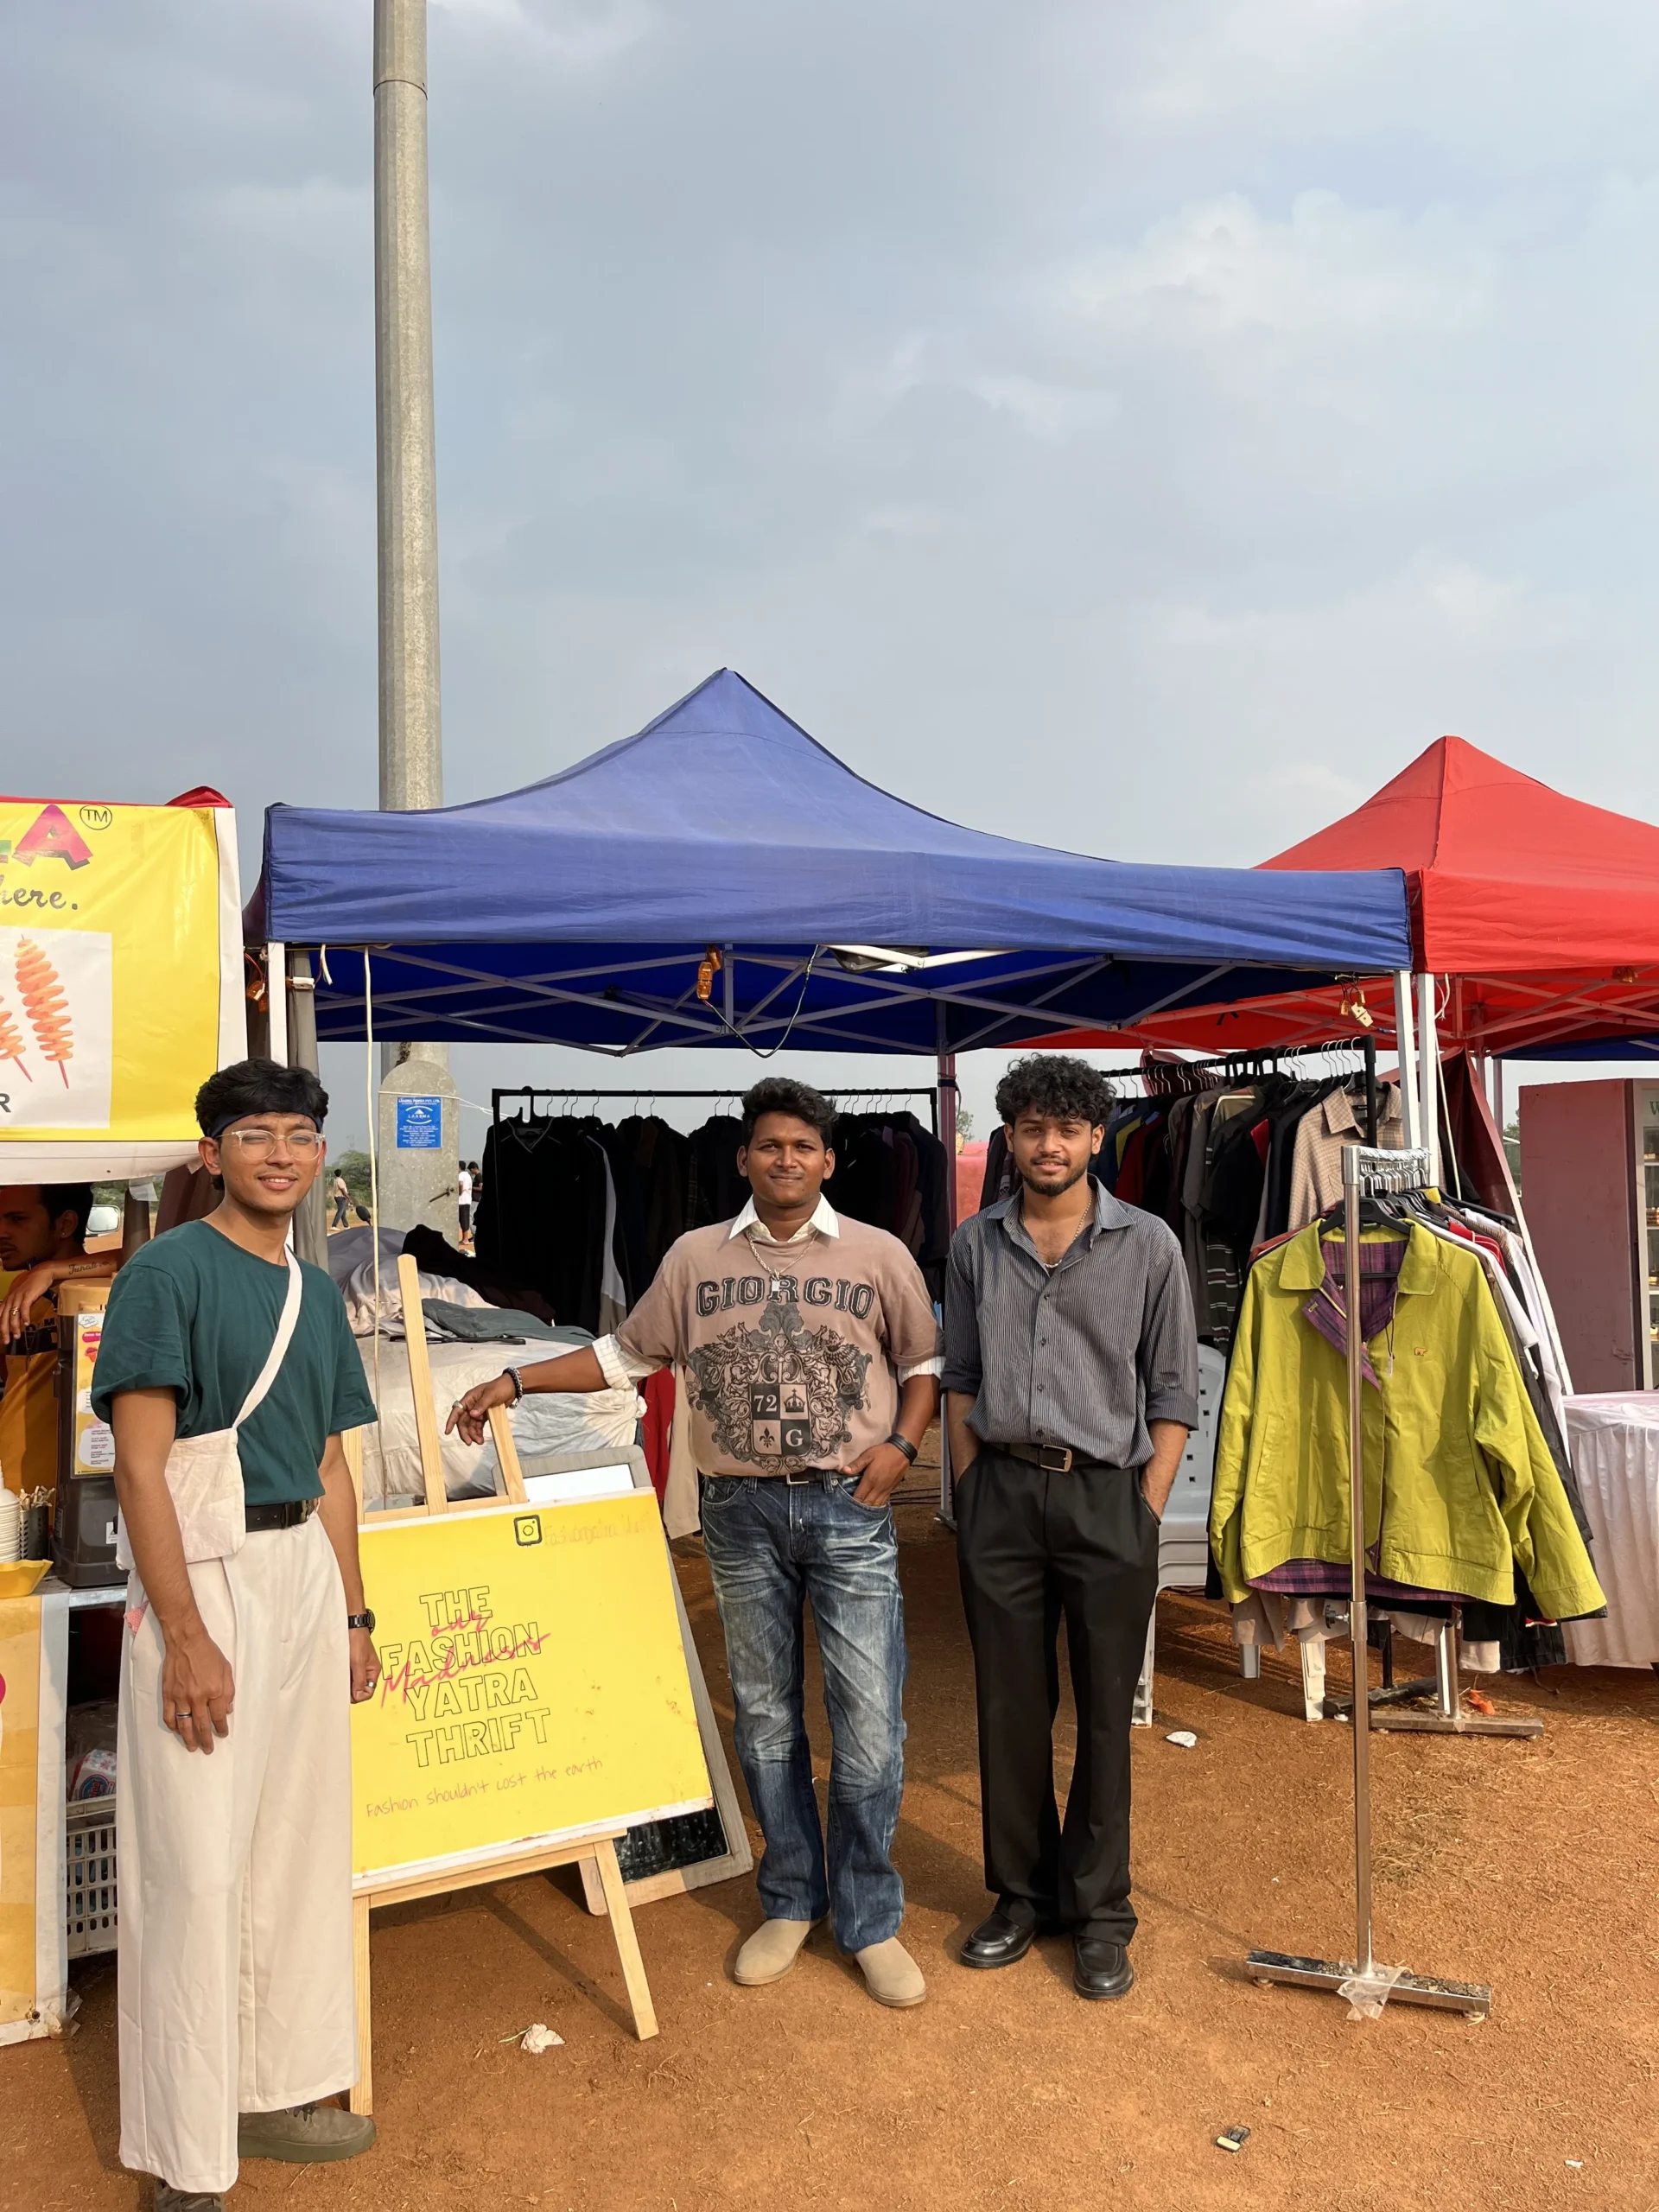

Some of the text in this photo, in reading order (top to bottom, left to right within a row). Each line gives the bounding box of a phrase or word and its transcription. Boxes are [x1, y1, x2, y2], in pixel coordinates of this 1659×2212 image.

[0, 804, 93, 871] A
[696, 1274, 874, 1319] GIORGIO
[754, 1395, 778, 1413] 72
[785, 1428, 804, 1447] G
[419, 1586, 493, 1627] THE
[379, 1622, 542, 1680] FASHION
[404, 1668, 538, 1721] YATRA
[405, 1707, 551, 1767] THRIFT
[366, 1756, 603, 1817] Fashion shouldn't cost the earth
